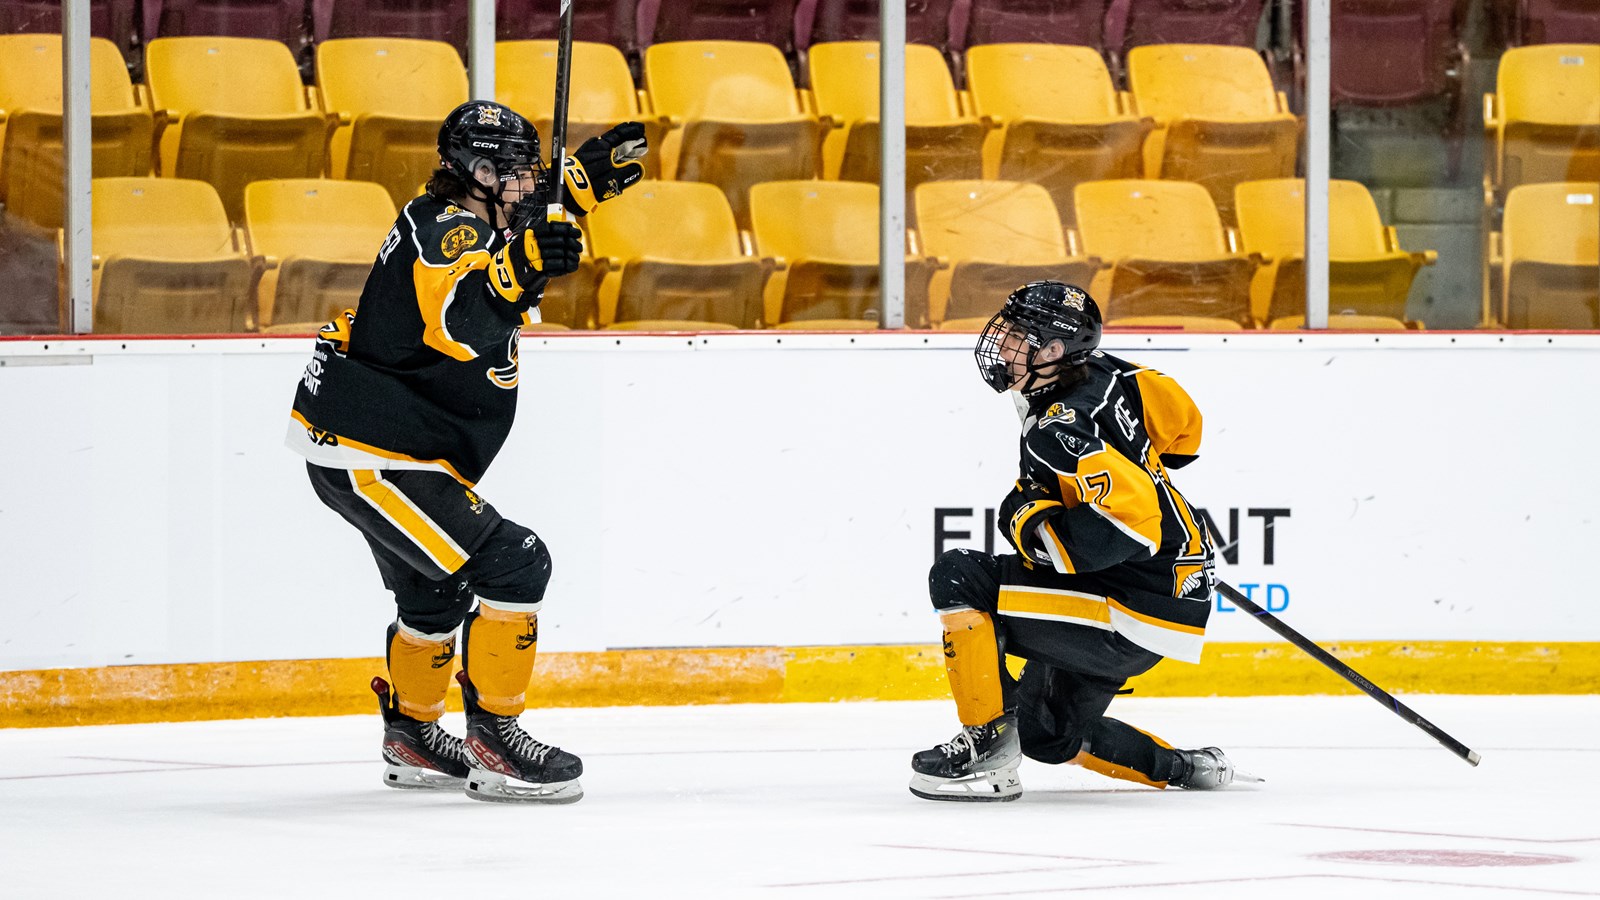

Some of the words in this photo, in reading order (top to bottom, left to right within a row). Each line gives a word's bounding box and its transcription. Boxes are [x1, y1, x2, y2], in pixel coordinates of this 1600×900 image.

[472, 141, 500, 150] CCM
[623, 172, 641, 184] CCM
[1052, 320, 1079, 333] CCM
[1216, 583, 1290, 613] LTD
[1346, 670, 1375, 692] TRIGGER
